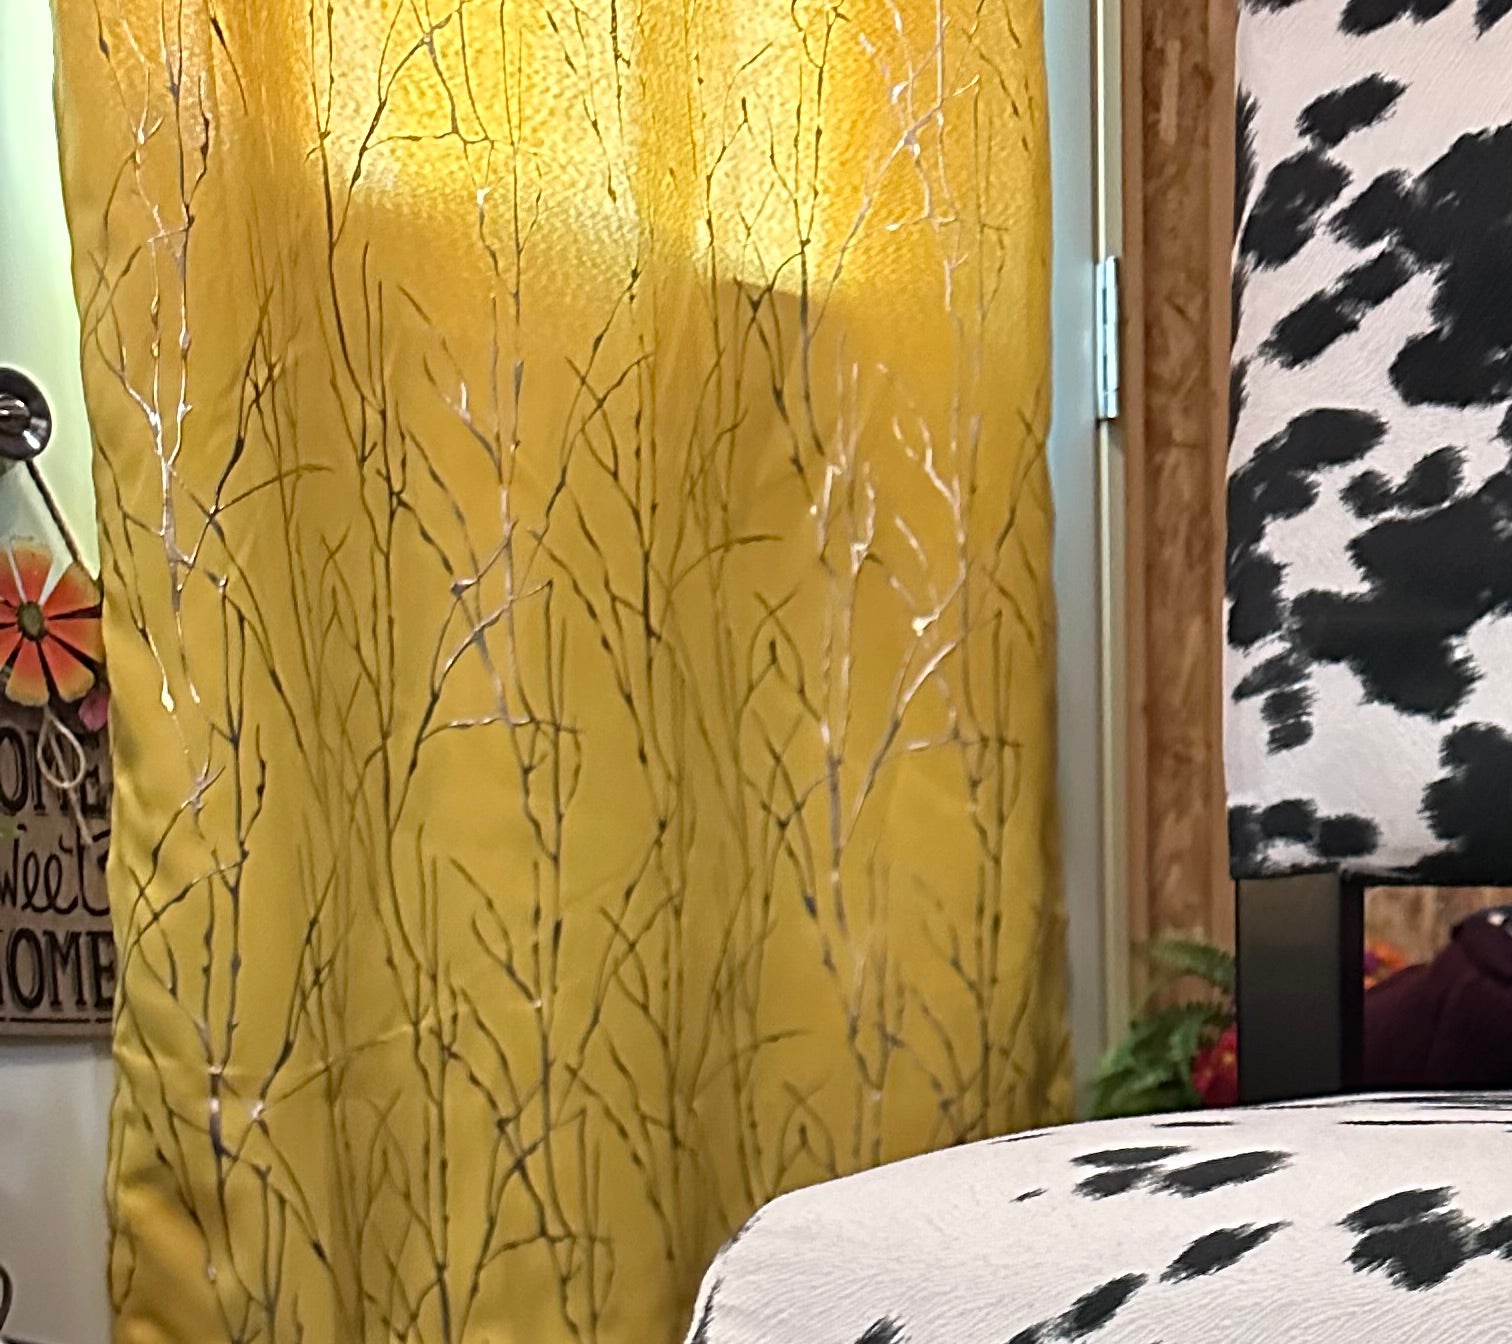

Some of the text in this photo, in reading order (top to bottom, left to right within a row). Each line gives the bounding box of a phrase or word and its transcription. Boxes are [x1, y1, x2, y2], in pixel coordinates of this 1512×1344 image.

[0, 727, 108, 818] OME
[0, 823, 111, 916] weet
[0, 928, 115, 1011] OME
